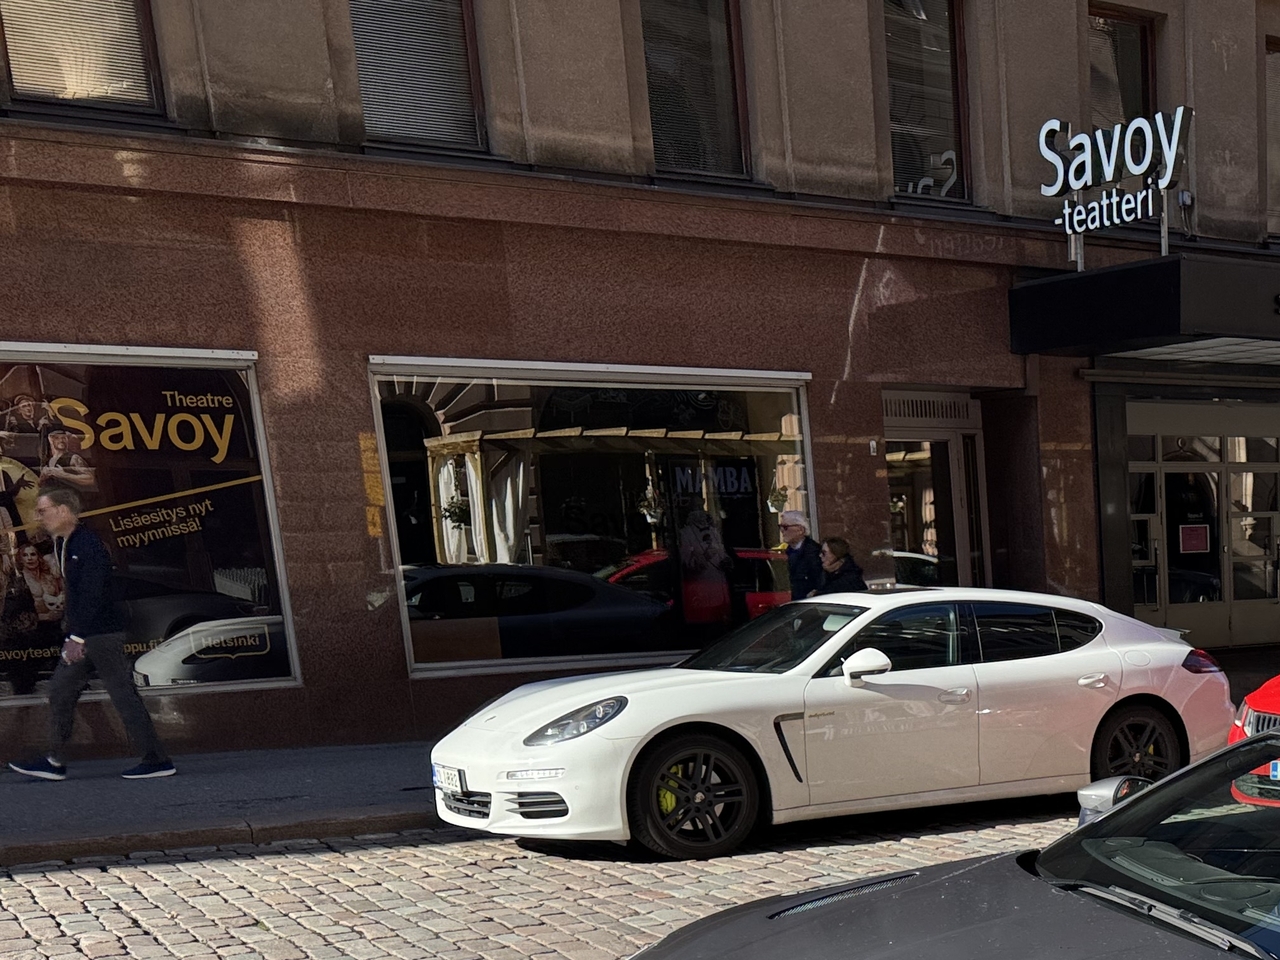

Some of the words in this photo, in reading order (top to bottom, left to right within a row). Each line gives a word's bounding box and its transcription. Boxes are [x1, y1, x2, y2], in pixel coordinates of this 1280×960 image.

[1038, 105, 1191, 197] Savoy
[1054, 177, 1156, 235] -teatteri
[162, 390, 234, 408] Theatre
[50, 397, 235, 464] Savoy
[674, 466, 754, 493] MAMBA
[109, 507, 186, 532] Lisäesitys
[189, 498, 214, 519] nyt
[116, 517, 202, 548] myynnissä!
[201, 634, 260, 649] Helsinki
